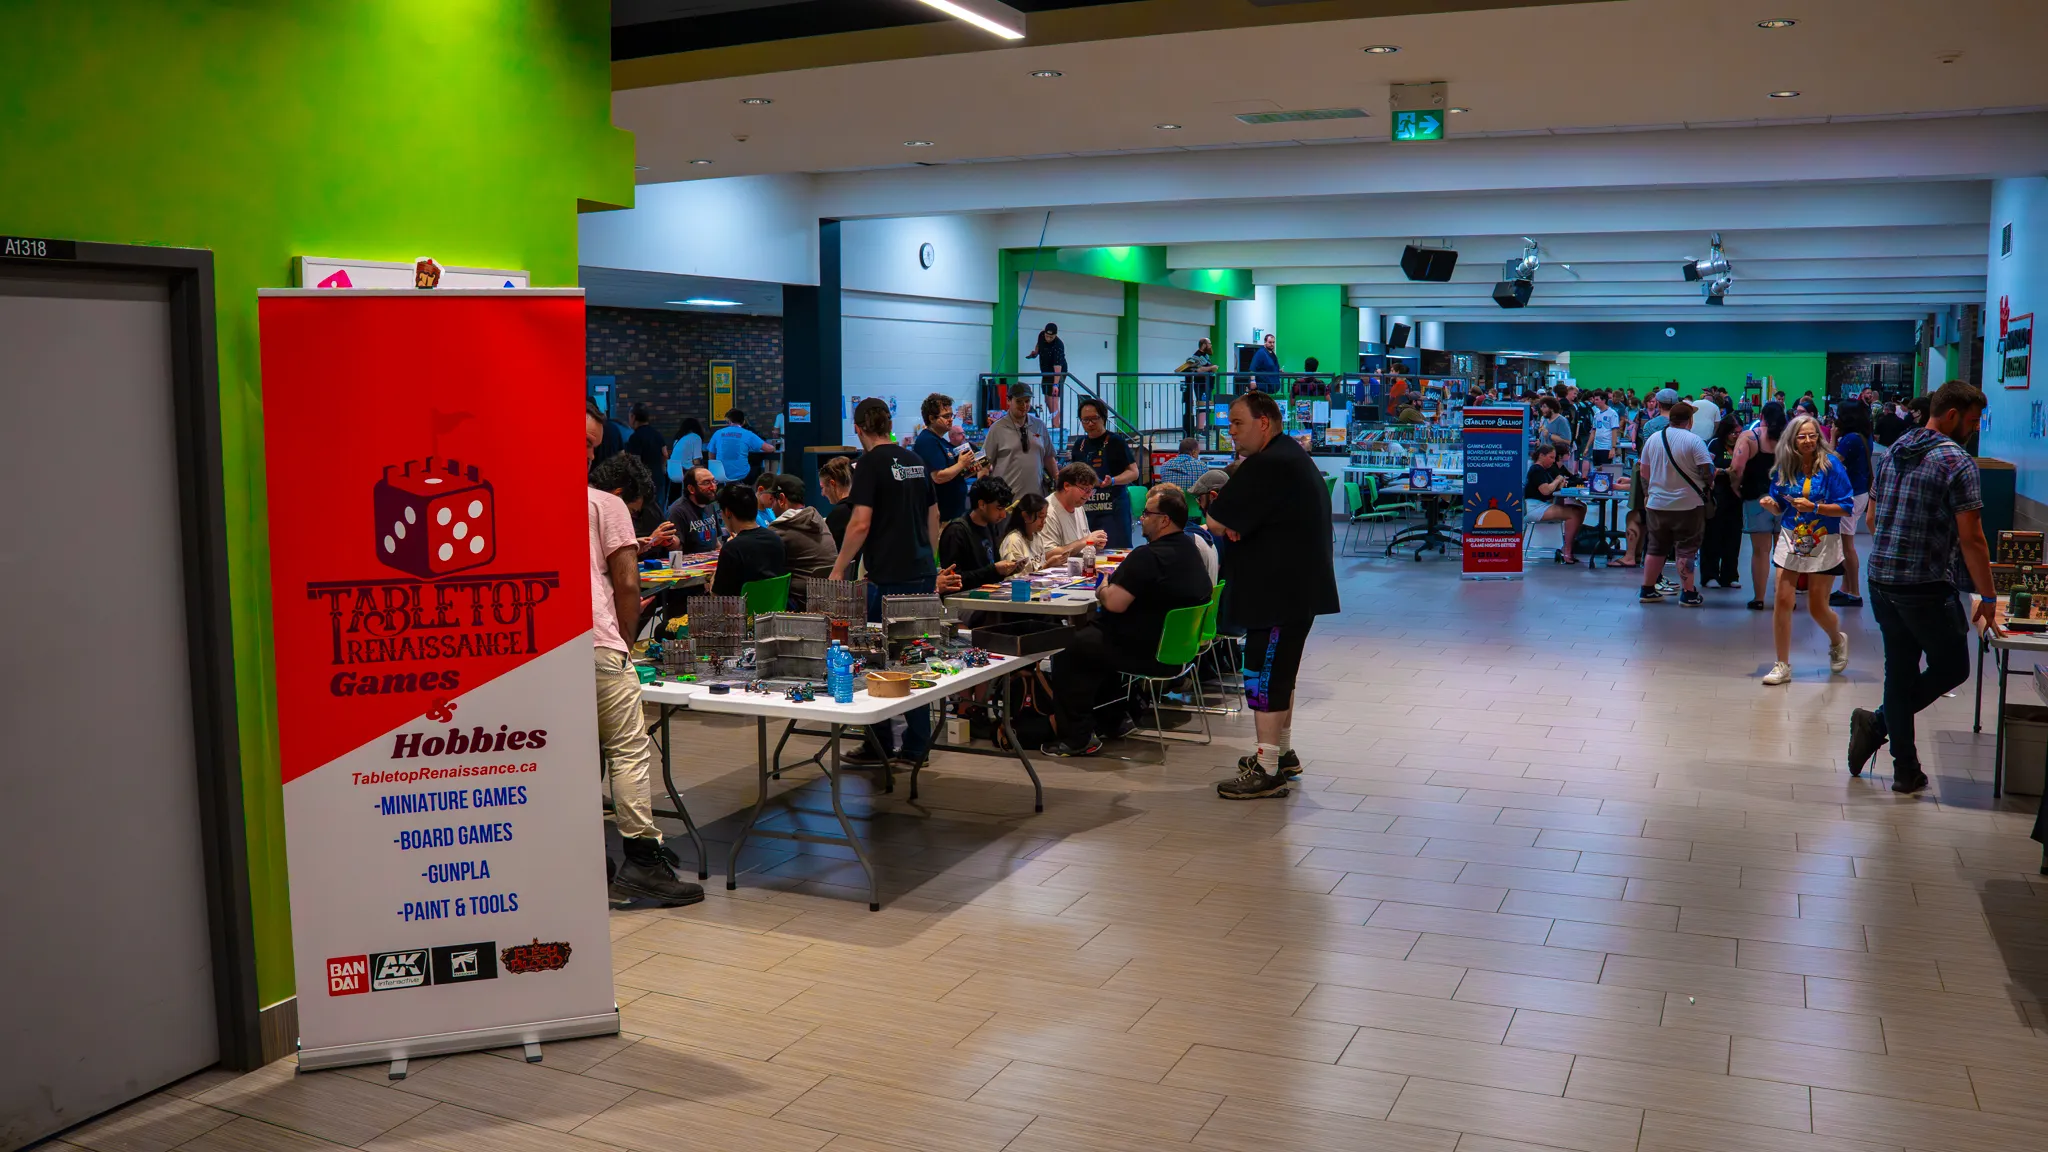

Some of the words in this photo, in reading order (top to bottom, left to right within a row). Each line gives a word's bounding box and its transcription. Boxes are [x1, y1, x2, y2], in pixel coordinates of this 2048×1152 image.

[5, 238, 47, 257] A1318
[1464, 417, 1496, 426] TABLETOP
[1497, 417, 1523, 427] BELLHOP
[317, 580, 551, 664] TABLETOP
[347, 631, 523, 664] RENAISSANCE
[330, 670, 460, 697] Games
[426, 697, 458, 723] &
[391, 724, 547, 759] Hobbies
[352, 762, 537, 786] TabletopRenaissance.ca
[374, 790, 469, 815] -MINIATURE
[473, 785, 527, 808] GAMES
[394, 827, 454, 850] -BOARD
[458, 822, 513, 845] GAMES
[422, 860, 490, 883] -GUNPLA
[397, 899, 450, 922] -PAINT
[455, 898, 466, 917] &
[469, 892, 518, 915] TOOLS
[329, 960, 365, 976] BAN
[378, 952, 422, 979] AK
[511, 955, 563, 969] BLOOD
[331, 977, 359, 992] DAI
[377, 977, 420, 987] interactive
